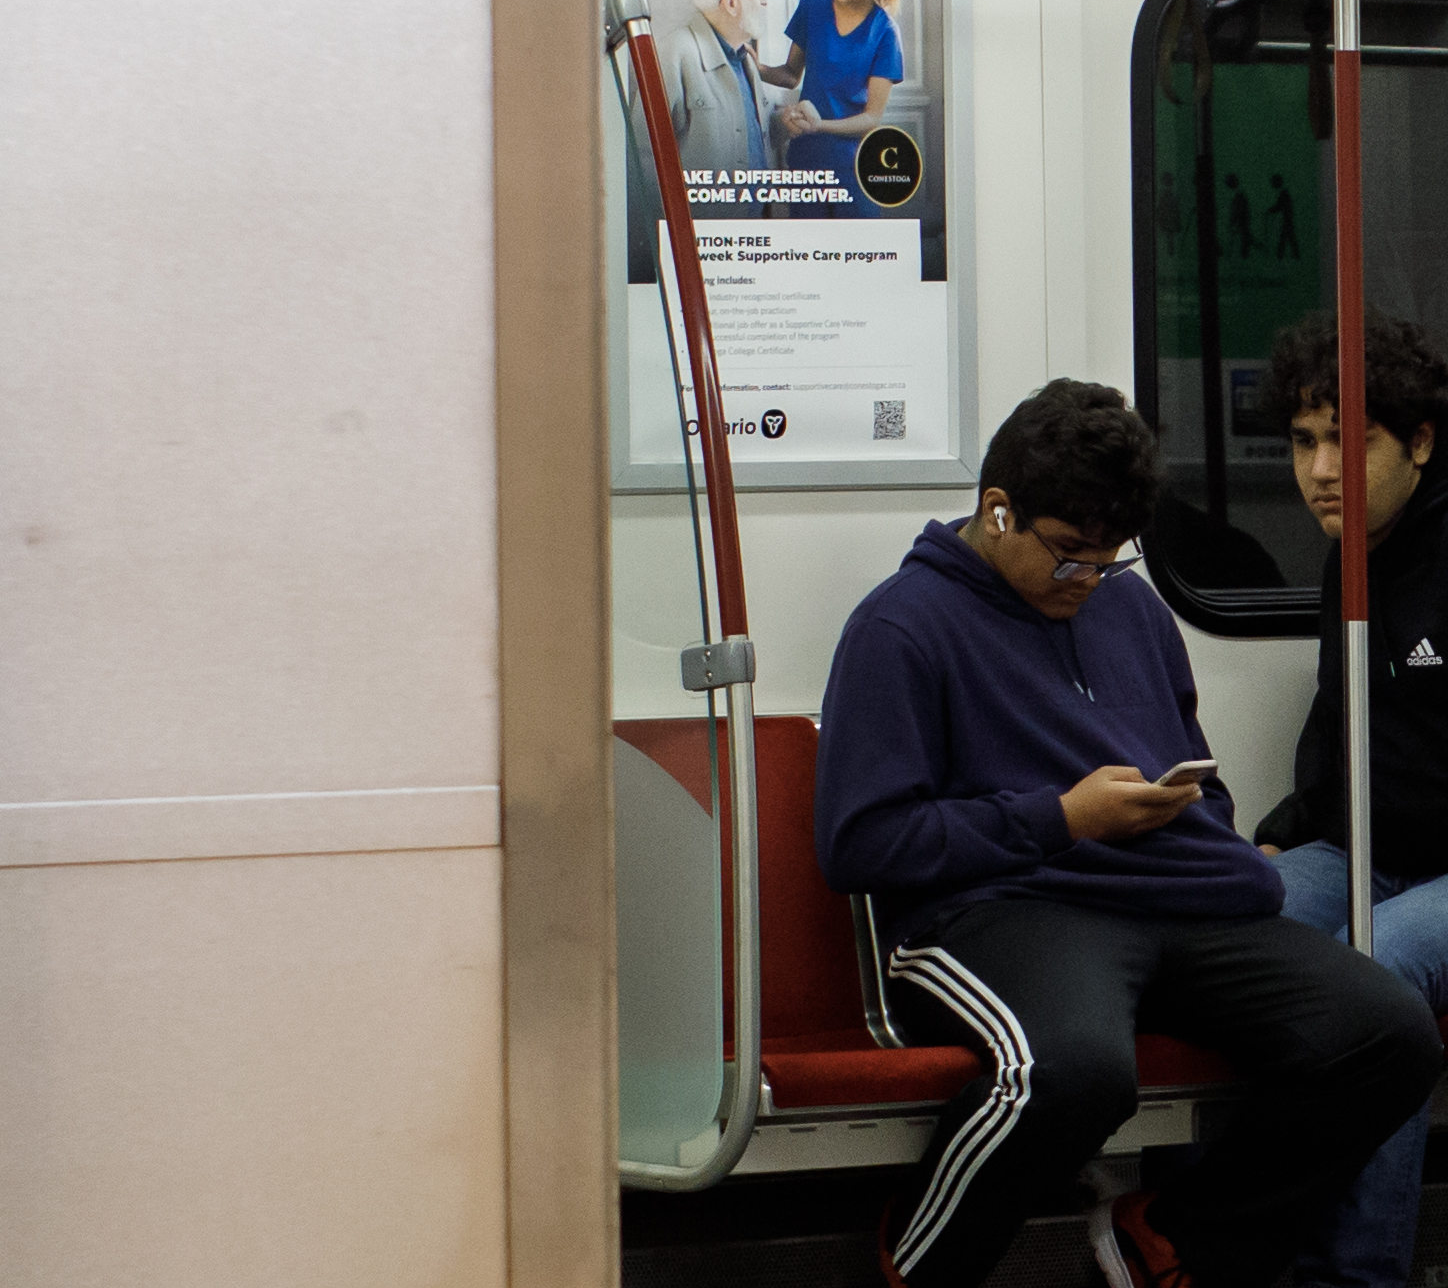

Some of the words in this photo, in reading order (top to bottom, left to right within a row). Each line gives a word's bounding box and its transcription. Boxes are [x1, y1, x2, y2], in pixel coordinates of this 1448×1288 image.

[683, 170, 713, 184] AKE
[717, 170, 731, 184] A
[734, 170, 840, 185] DIFFERENCE.
[868, 175, 911, 183] CONESTOGA
[687, 188, 736, 203] COME
[739, 188, 753, 203] A
[756, 188, 853, 203] CAREGIVER.
[697, 236, 771, 247] ITION-FREE
[737, 249, 809, 263] Supportive
[812, 250, 841, 261] Care
[844, 250, 898, 263] program
[717, 275, 756, 285] includes:
[686, 417, 757, 436] Oario
[1407, 655, 1443, 666] adidas
